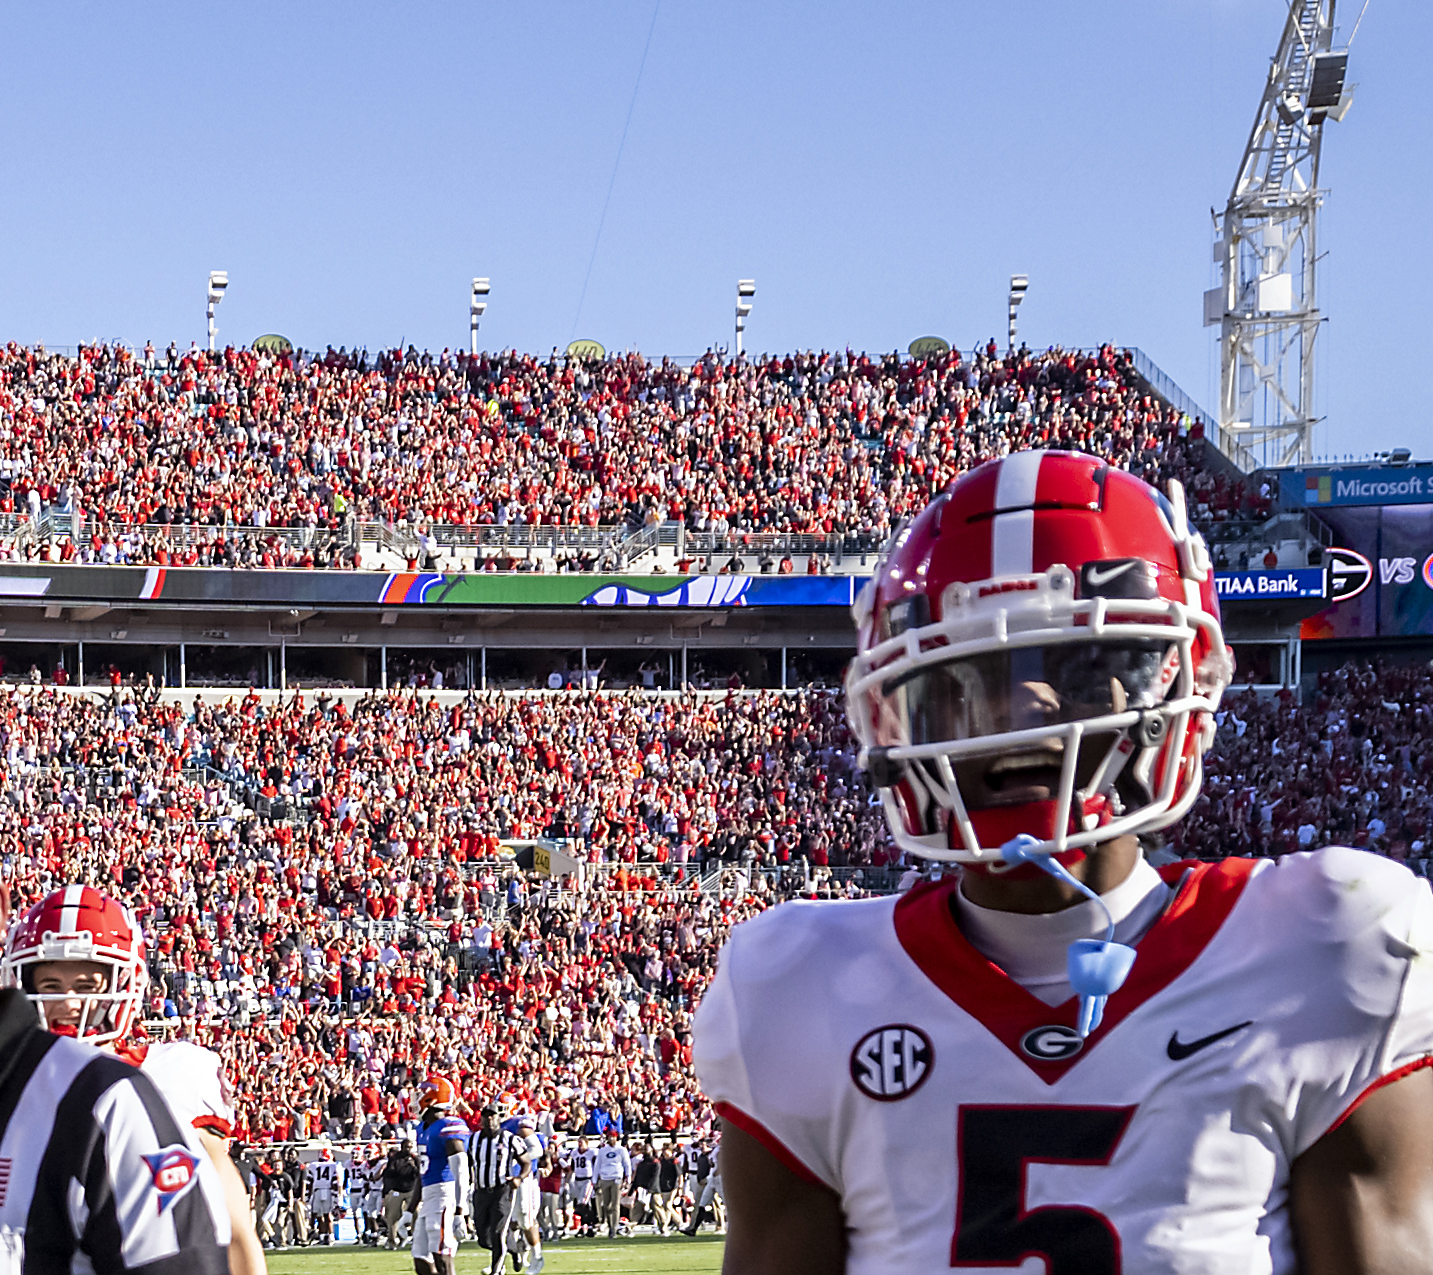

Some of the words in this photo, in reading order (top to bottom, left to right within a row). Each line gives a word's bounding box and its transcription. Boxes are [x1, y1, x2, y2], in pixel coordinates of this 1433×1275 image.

[1336, 476, 1423, 498] Microsoft
[1379, 557, 1417, 584] VS
[1214, 577, 1256, 594] TIAA
[1258, 574, 1299, 594] Bank
[855, 1030, 932, 1097] SEC
[316, 1166, 330, 1181] 14
